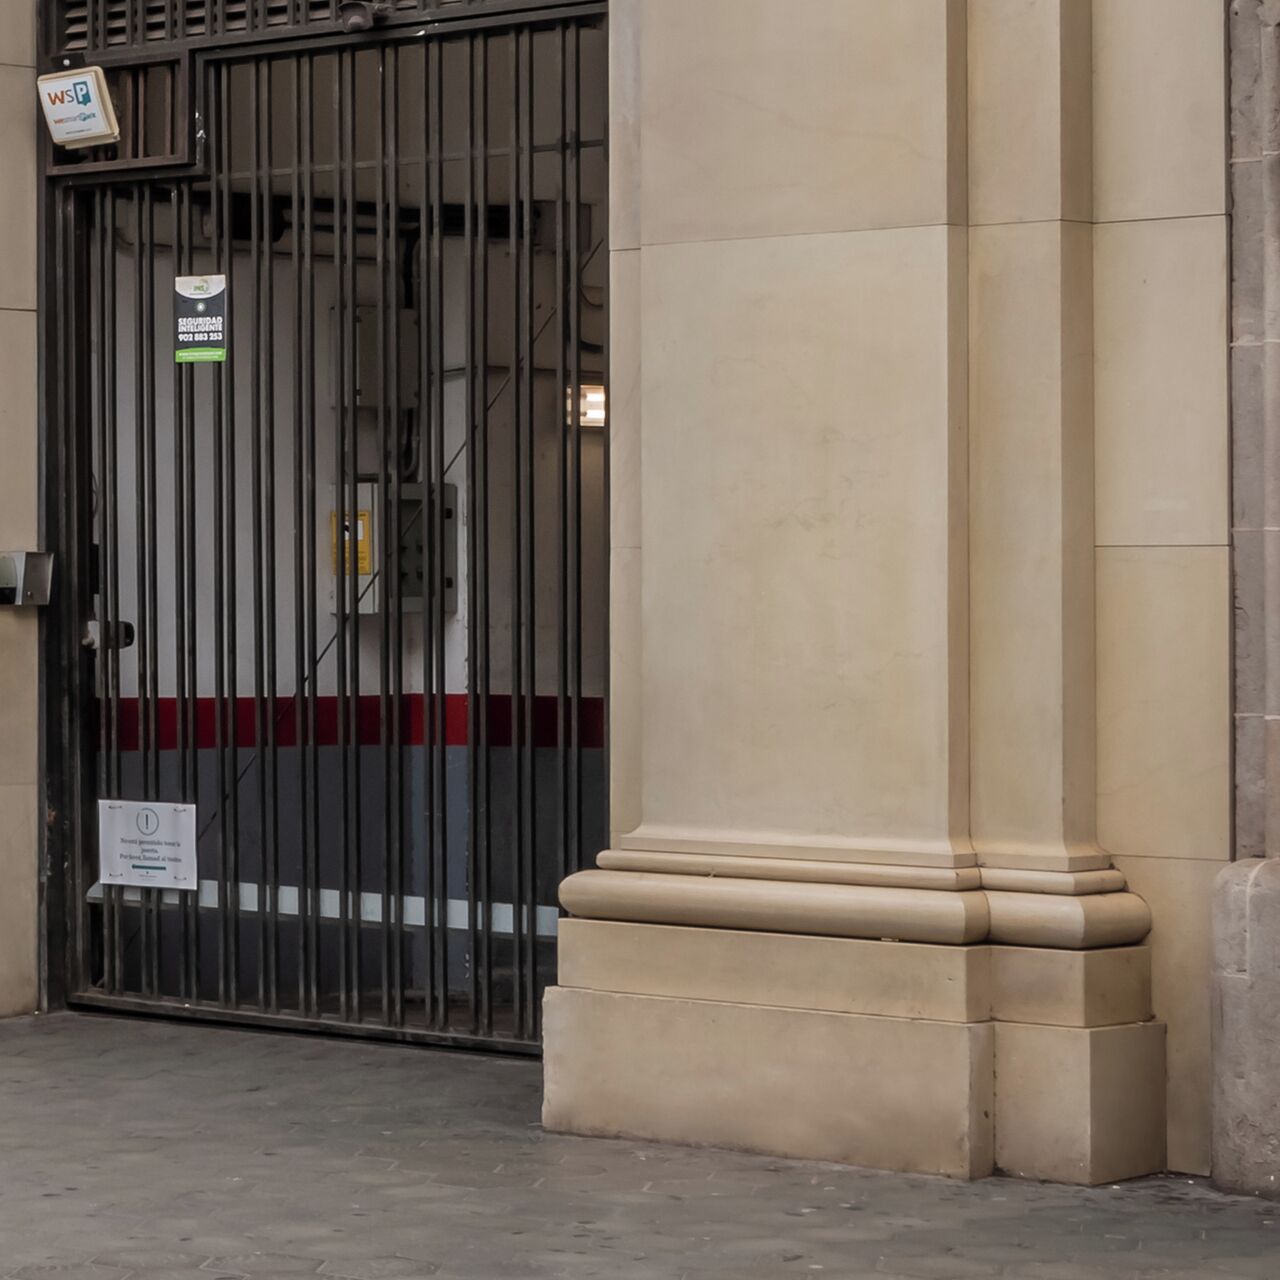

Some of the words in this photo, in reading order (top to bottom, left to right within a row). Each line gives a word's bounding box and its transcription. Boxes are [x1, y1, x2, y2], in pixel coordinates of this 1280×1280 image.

[178, 316, 223, 325] SEGURIDAD
[178, 324, 223, 332] INTELIGENTE
[178, 333, 193, 341] 902
